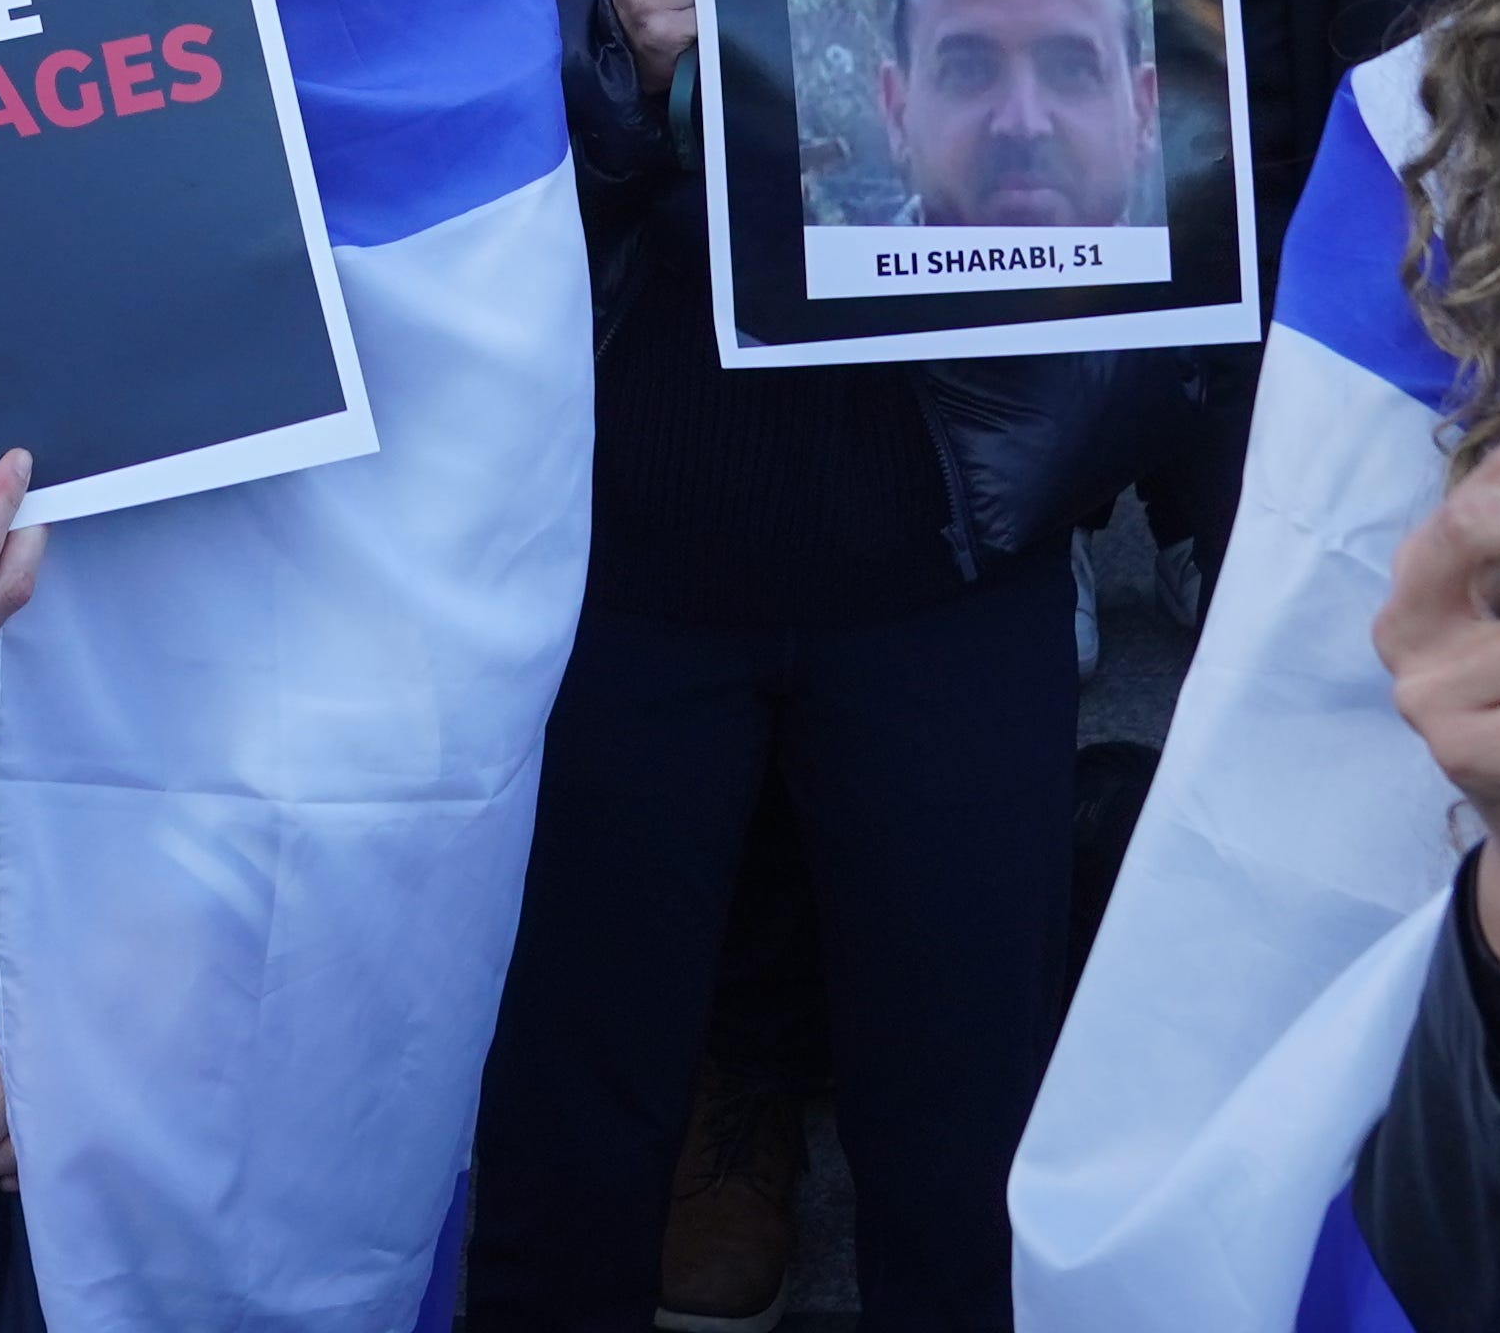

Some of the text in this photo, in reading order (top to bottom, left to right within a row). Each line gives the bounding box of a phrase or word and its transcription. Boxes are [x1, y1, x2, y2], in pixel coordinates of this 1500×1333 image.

[876, 243, 1103, 277] ELI SHARABI, 51
